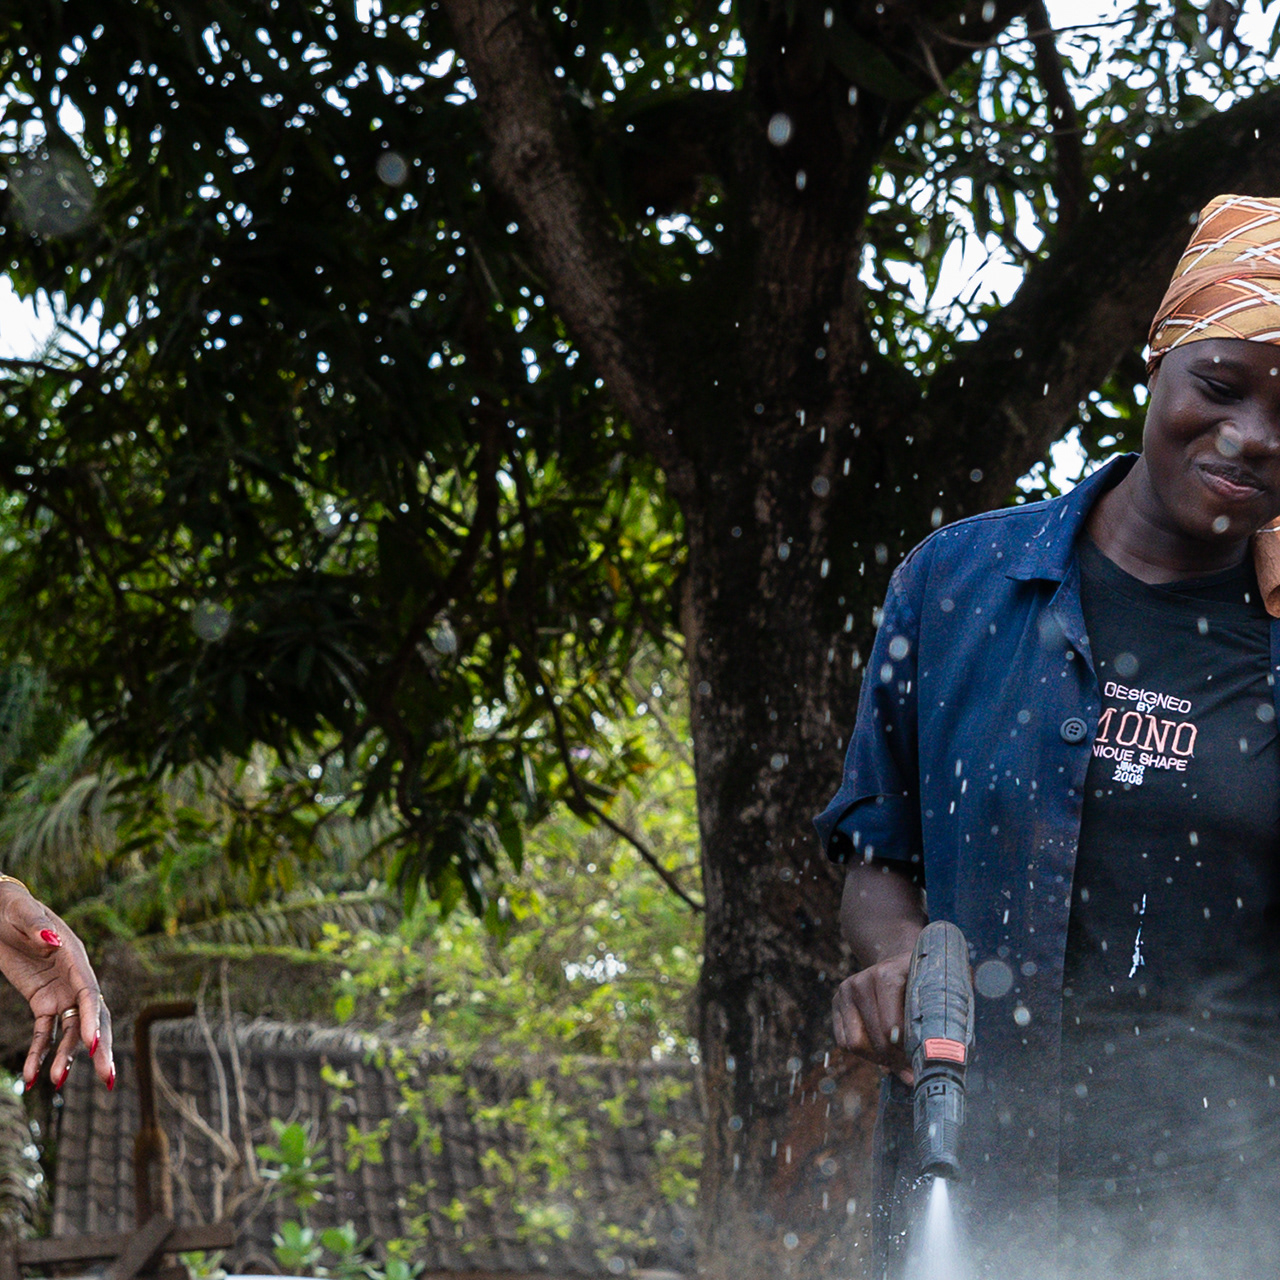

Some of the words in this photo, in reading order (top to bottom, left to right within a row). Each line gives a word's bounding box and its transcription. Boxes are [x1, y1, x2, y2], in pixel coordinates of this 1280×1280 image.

[1104, 681, 1192, 713] DESIGNED
[1136, 701, 1155, 713] BY
[1139, 752, 1188, 771] SHAPE
[1111, 770, 1144, 785] 2008
